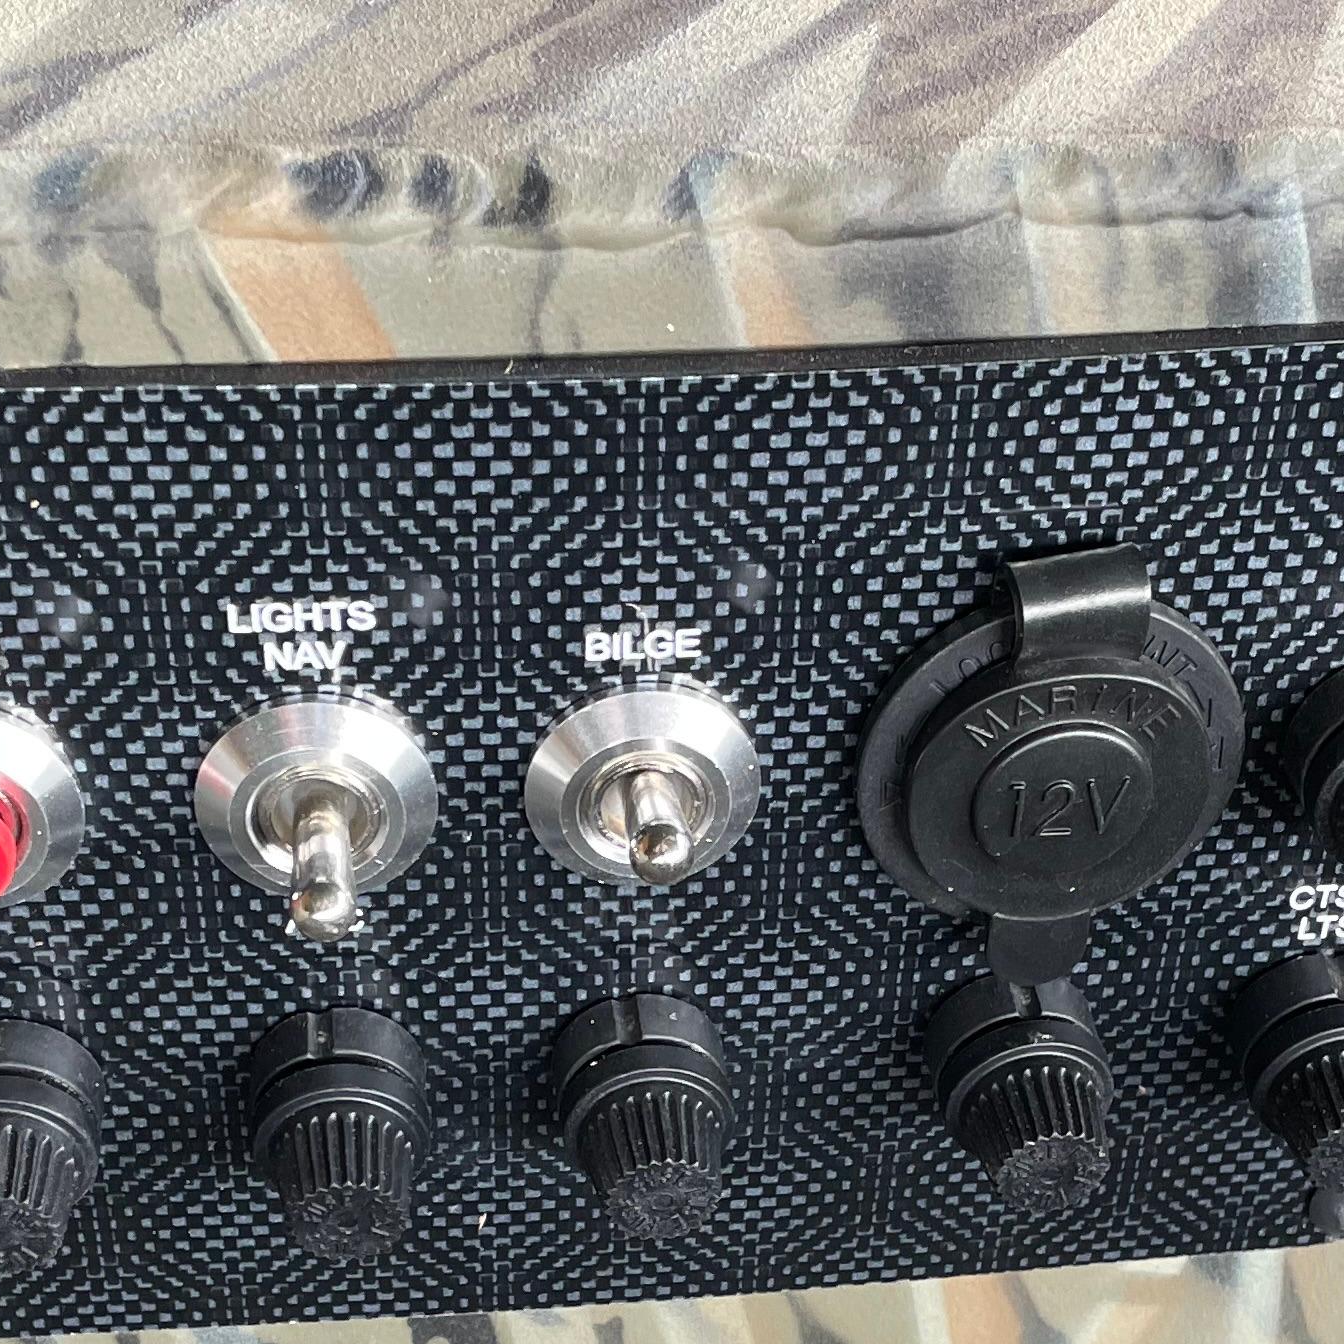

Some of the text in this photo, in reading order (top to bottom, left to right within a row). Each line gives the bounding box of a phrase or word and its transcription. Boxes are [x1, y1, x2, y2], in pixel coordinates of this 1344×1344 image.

[227, 600, 376, 633] LIGHTS
[263, 640, 347, 671] NAV
[585, 628, 702, 661] BILGE
[964, 682, 1182, 748] MARINE
[1010, 773, 1132, 838] 12V
